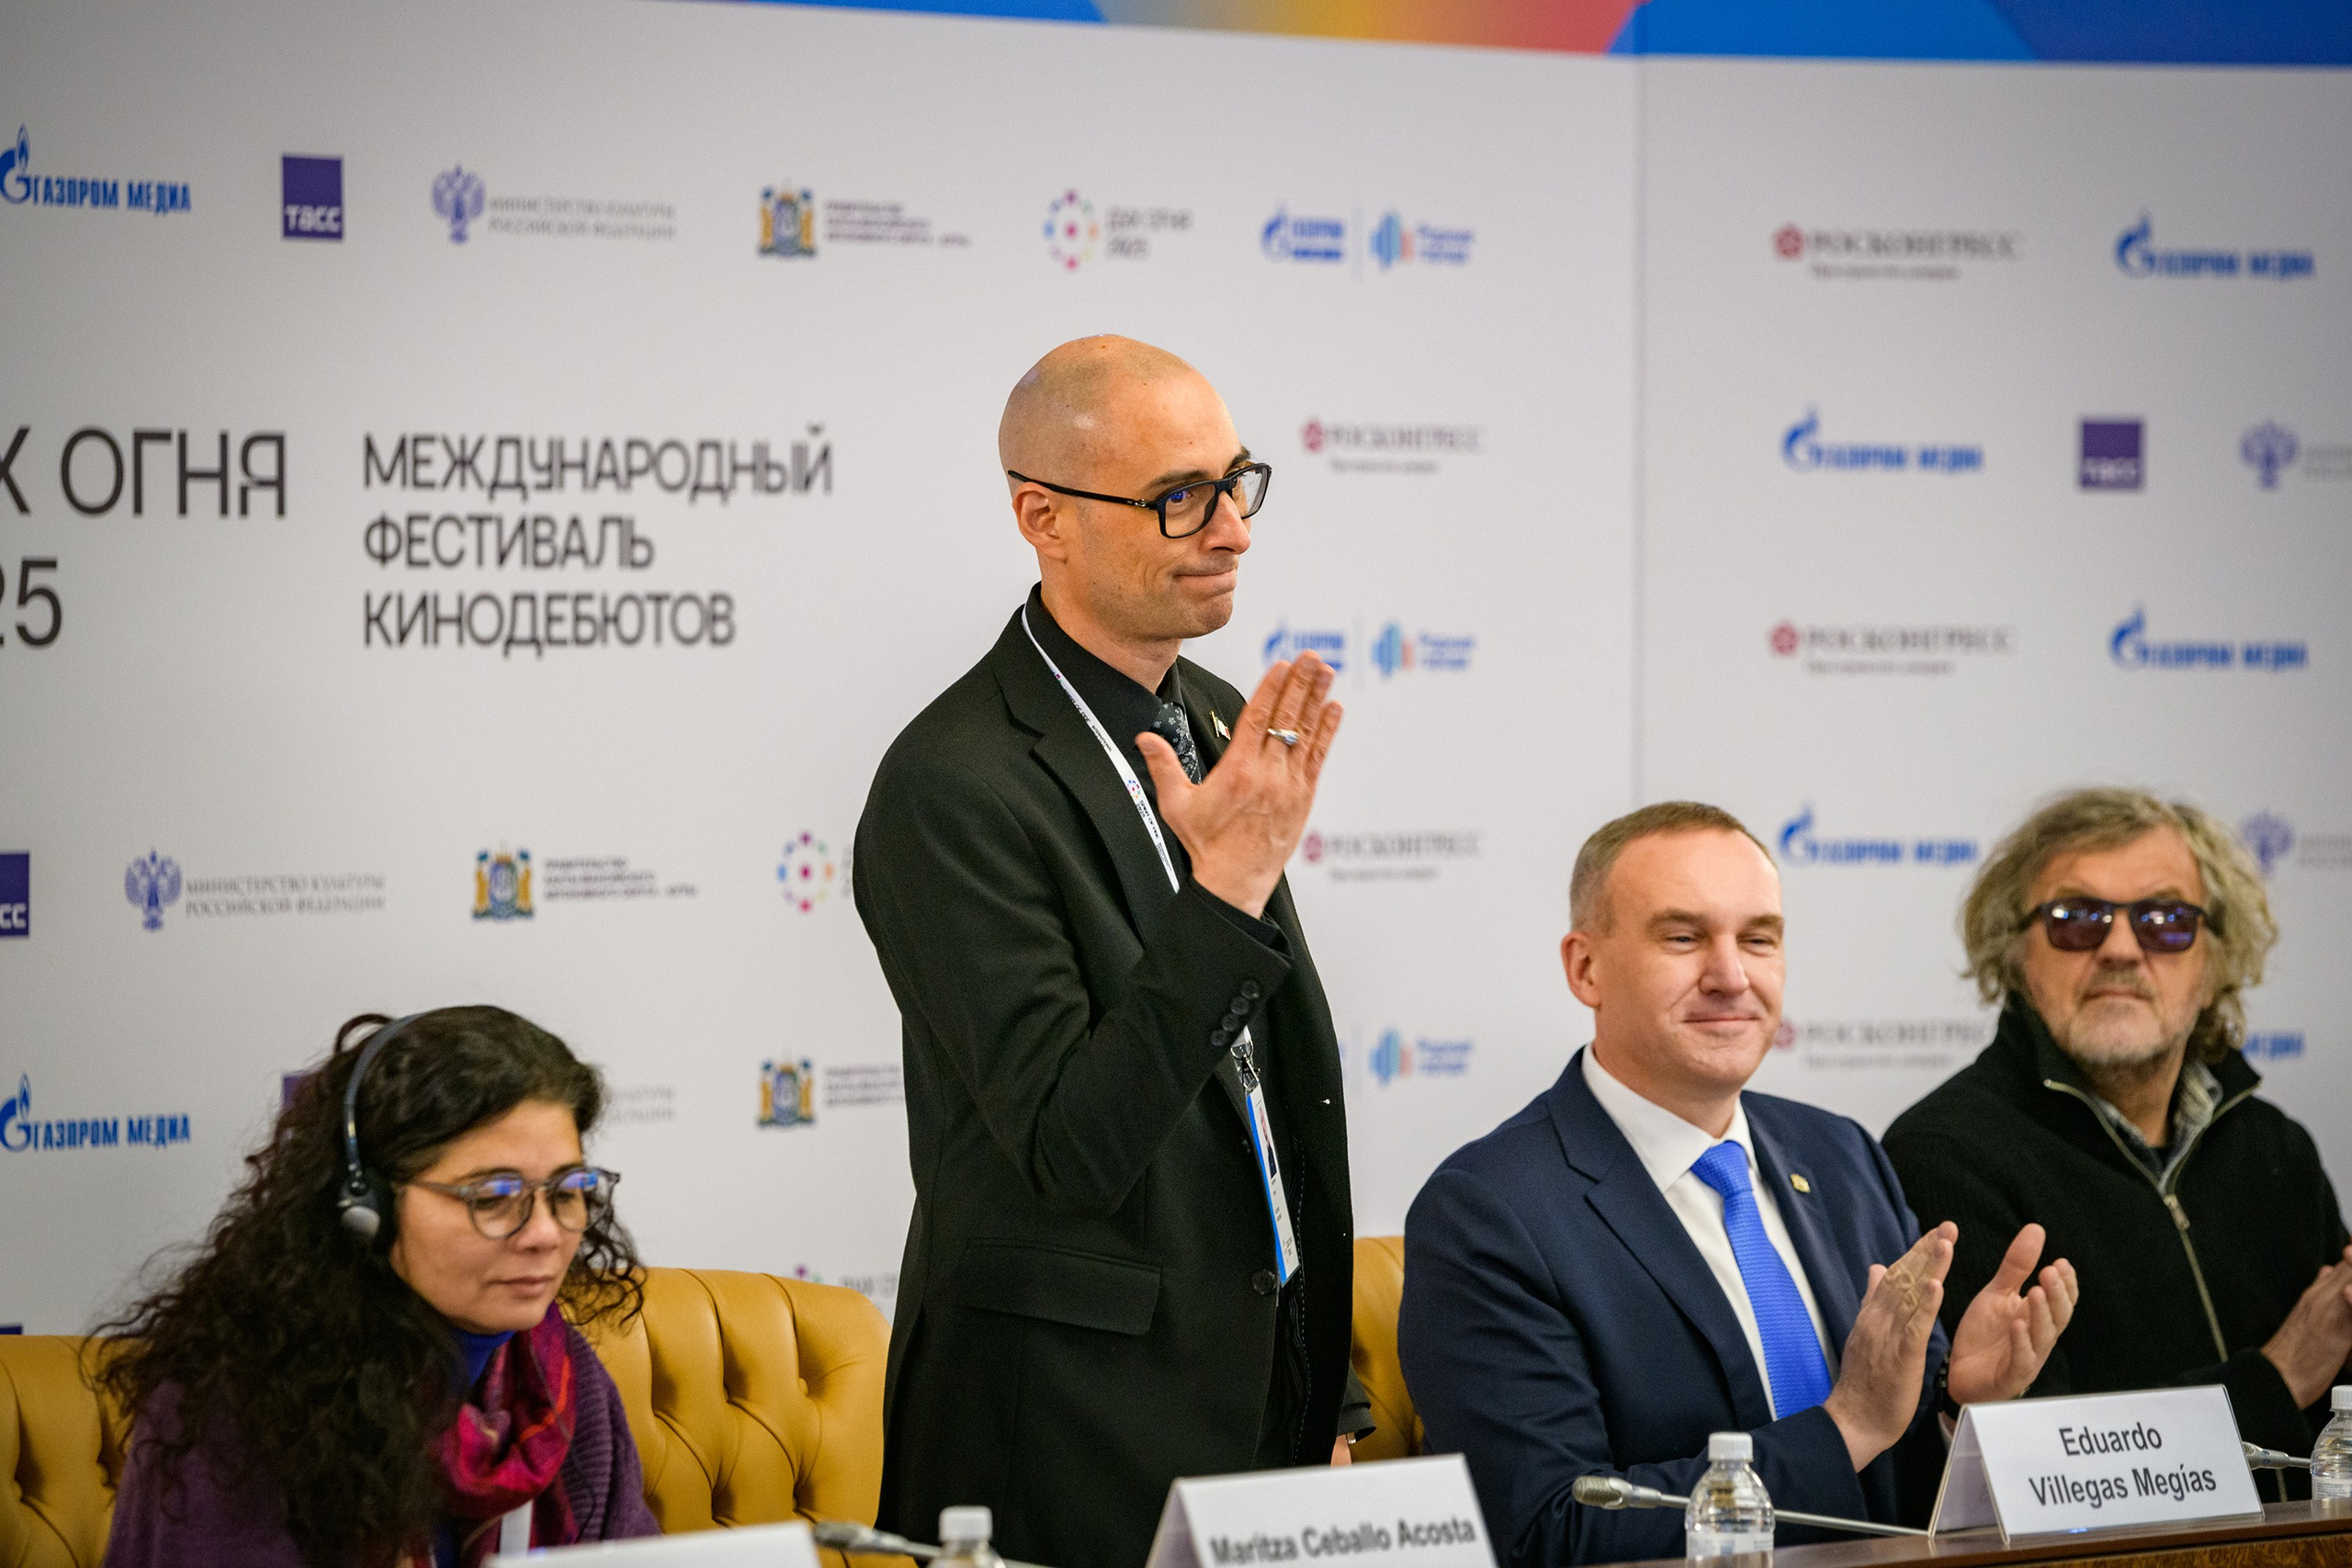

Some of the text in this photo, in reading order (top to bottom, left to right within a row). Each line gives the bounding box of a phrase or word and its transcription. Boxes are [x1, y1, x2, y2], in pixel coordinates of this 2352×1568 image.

[33, 175, 191, 217] ГАЗПРОМ МЕДИА
[61, 424, 287, 519] ОГНЯ
[364, 423, 833, 506] МЕЖДУНАРОДНЫЙ
[364, 512, 655, 570] ФЕСТИВАЛЬ
[0, 556, 62, 647] 5
[364, 591, 736, 660] КИНОДЕБЮТОВ
[33, 1111, 190, 1152] ГАЗПРОМ МЕДИА
[2059, 1422, 2163, 1456] Eduardo
[2029, 1463, 2217, 1509] Villegas Megías
[1210, 1516, 1476, 1564] Maritza Ceballo Acosta
